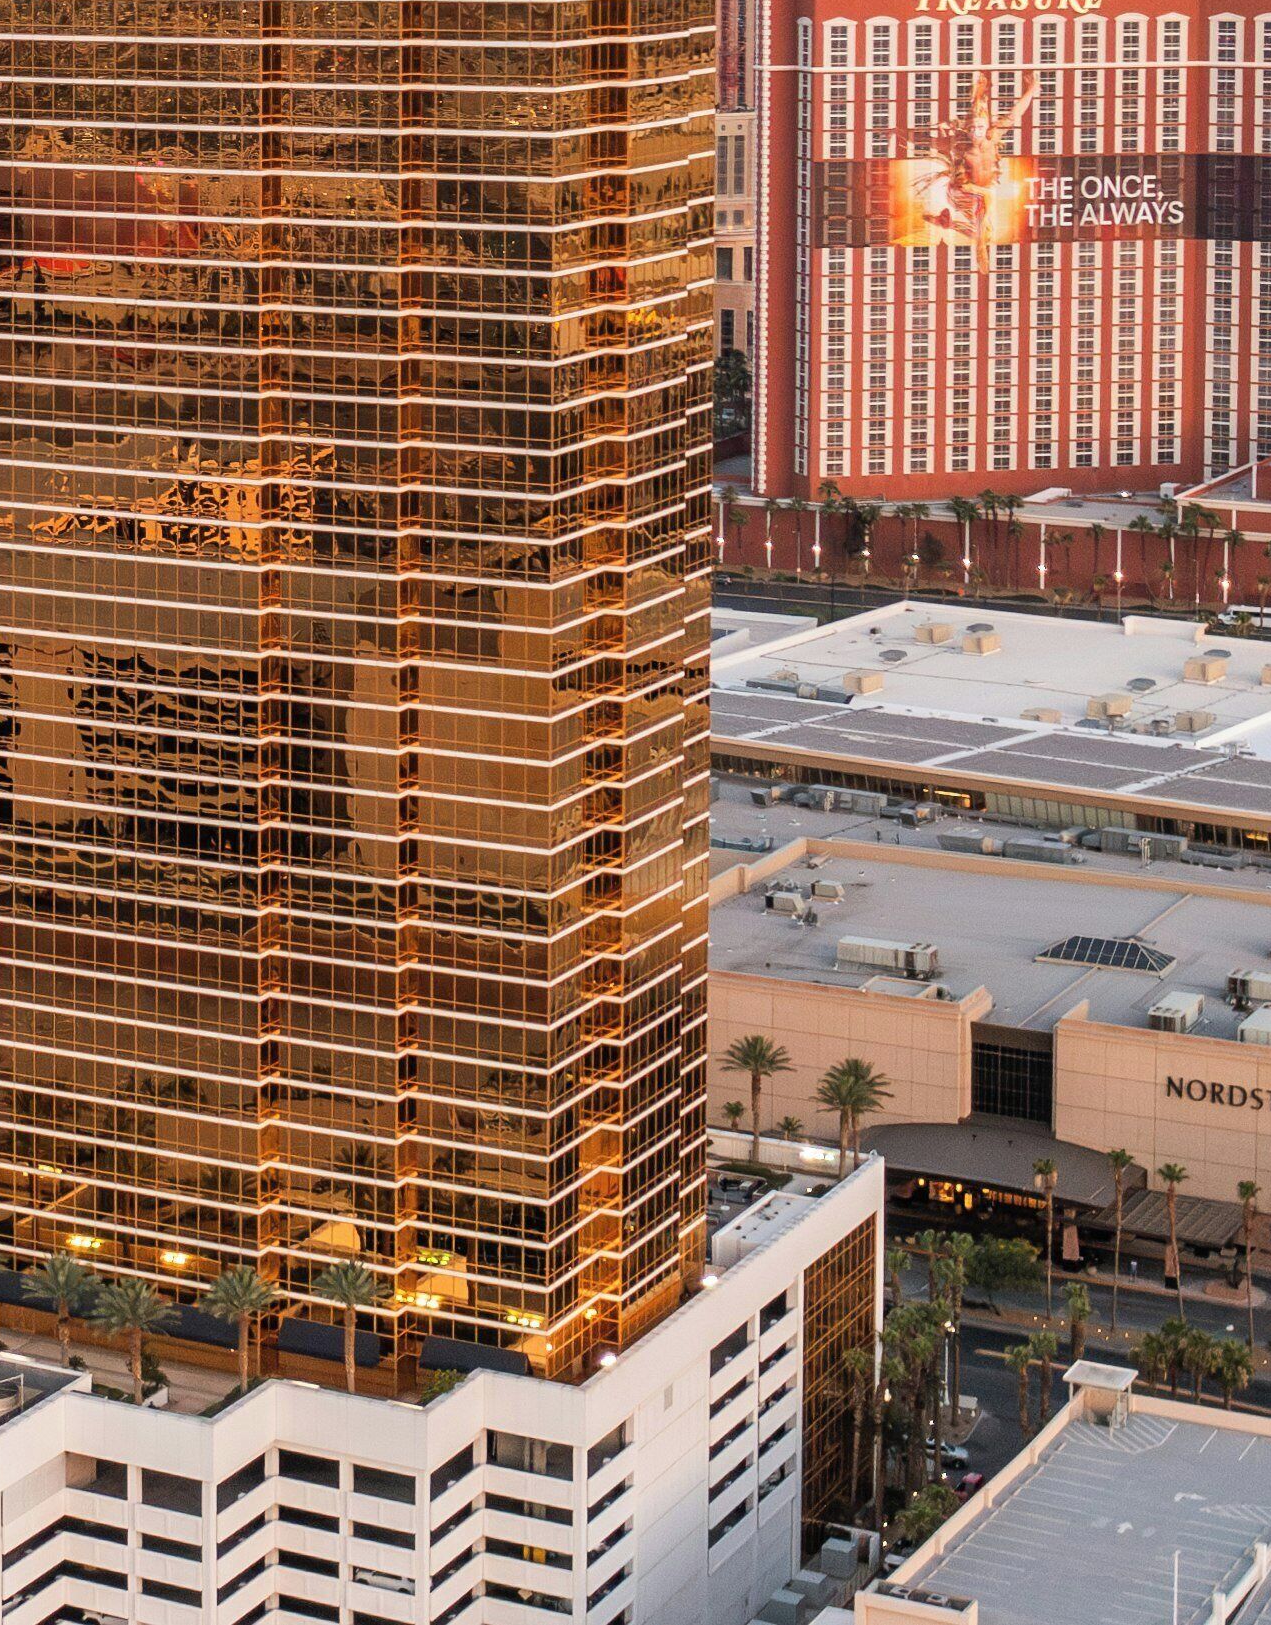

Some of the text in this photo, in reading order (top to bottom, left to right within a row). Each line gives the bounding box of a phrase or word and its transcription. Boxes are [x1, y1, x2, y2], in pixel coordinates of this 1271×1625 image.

[1024, 175, 1164, 201] THE ONCE,
[1024, 201, 1185, 227] THE ALWAYS
